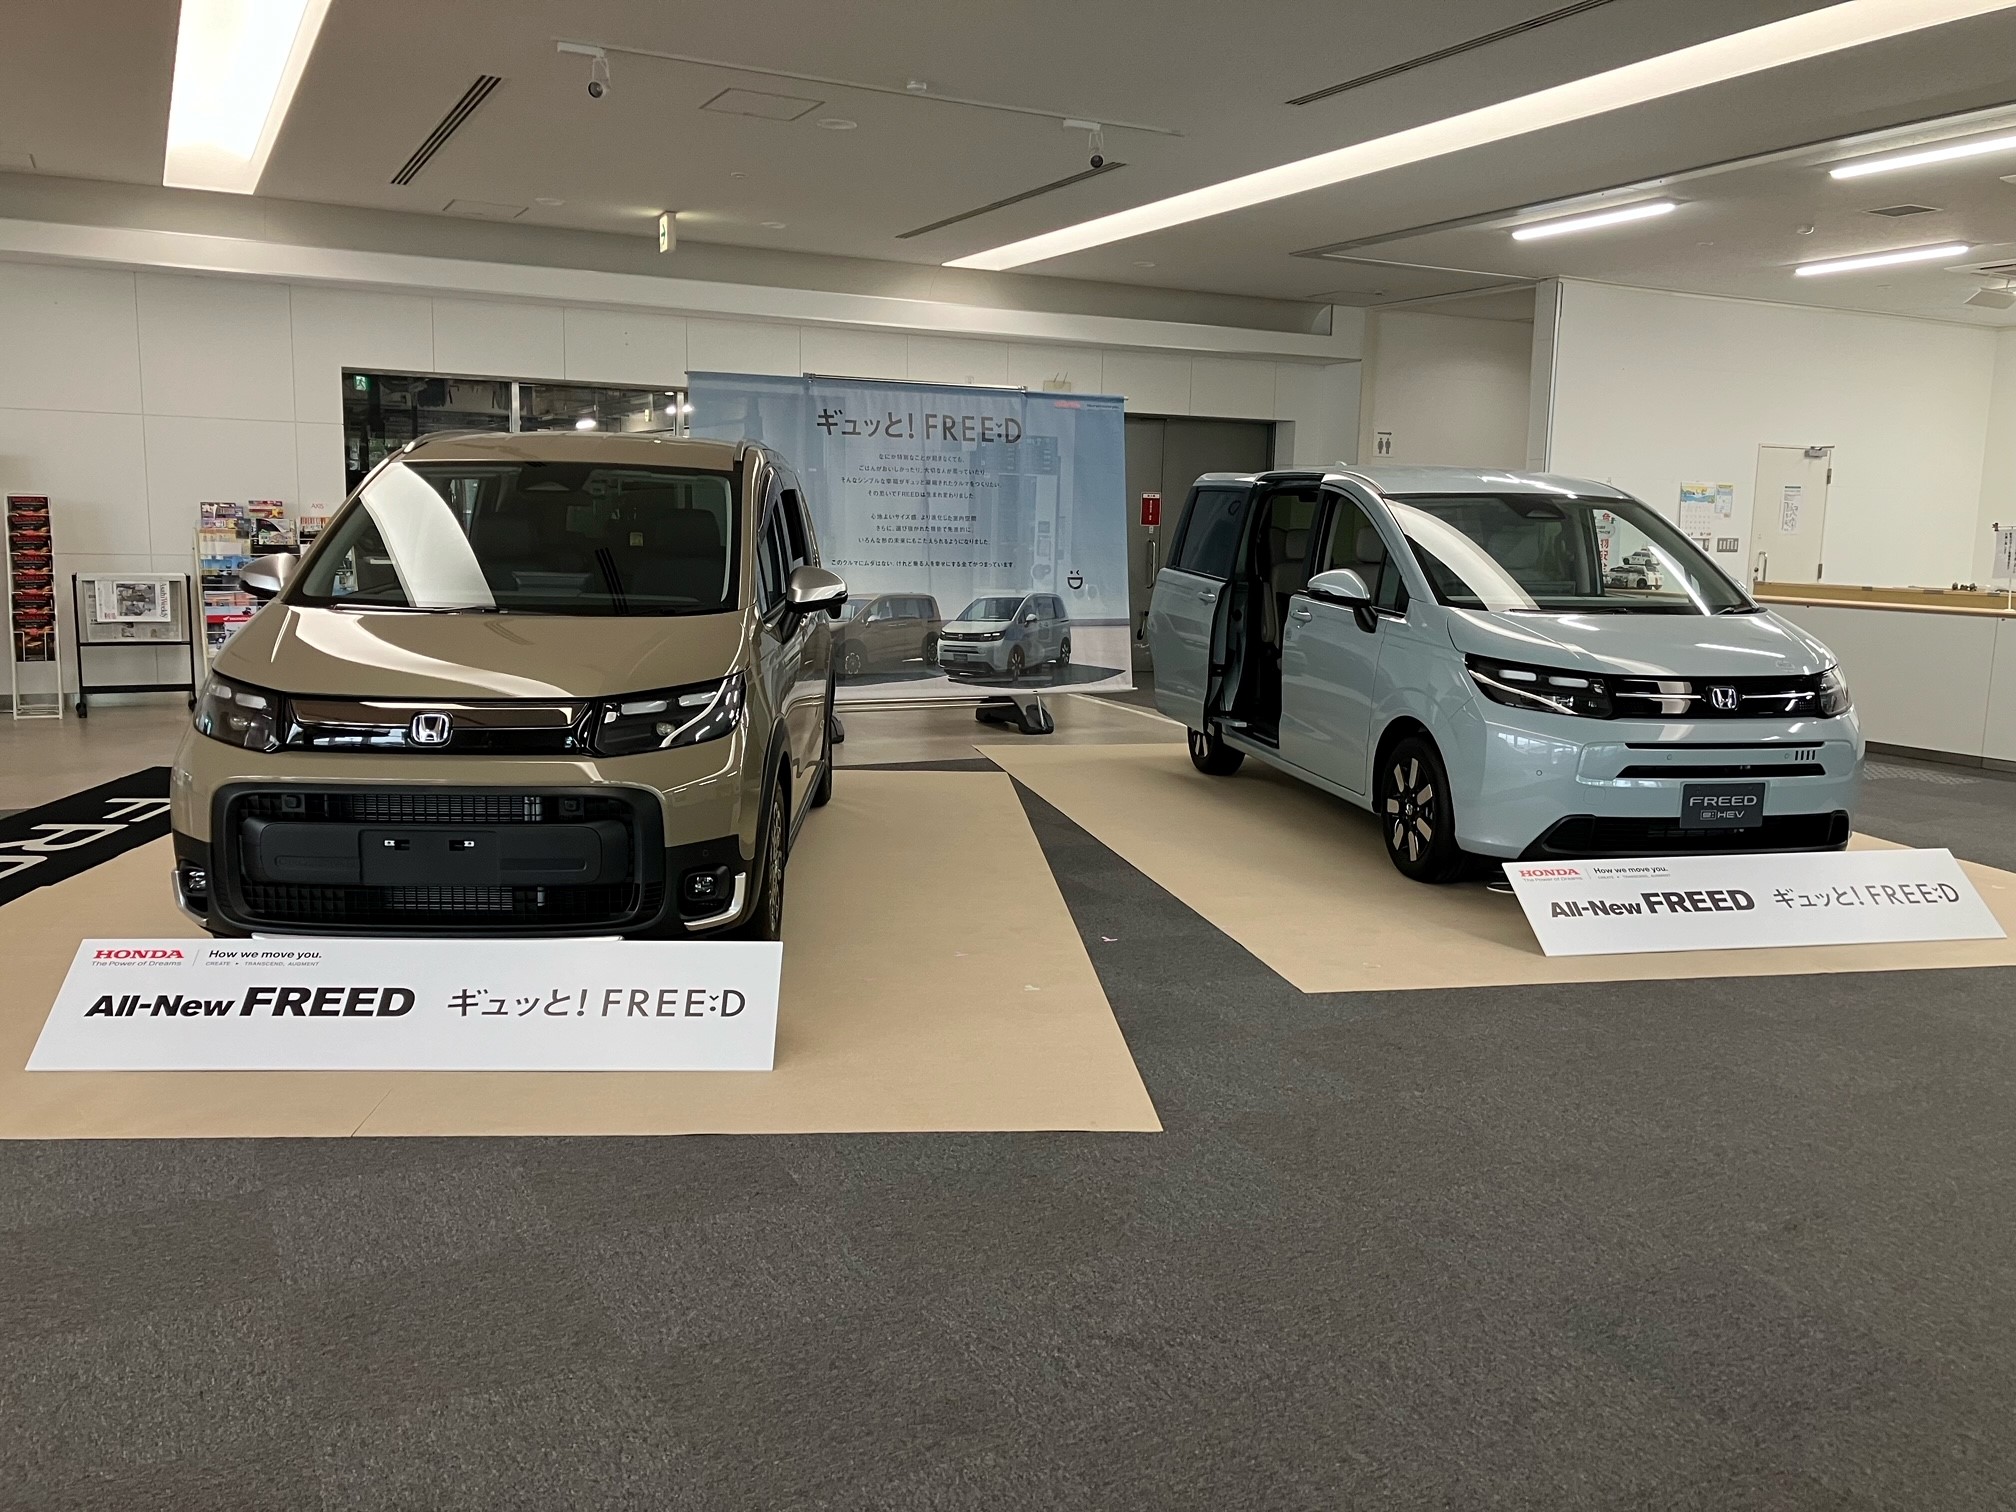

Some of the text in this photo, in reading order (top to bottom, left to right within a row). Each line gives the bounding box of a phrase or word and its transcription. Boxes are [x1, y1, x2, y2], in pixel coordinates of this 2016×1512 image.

[1689, 795, 1757, 807] FREED
[1519, 869, 1581, 877] HONDA
[1551, 900, 1642, 918] All-New
[1640, 889, 1756, 914] FREED
[93, 949, 184, 959] HONDA
[209, 950, 238, 958] How
[296, 951, 322, 961] you.
[84, 994, 236, 1017] All-New
[239, 986, 416, 1017] FREED
